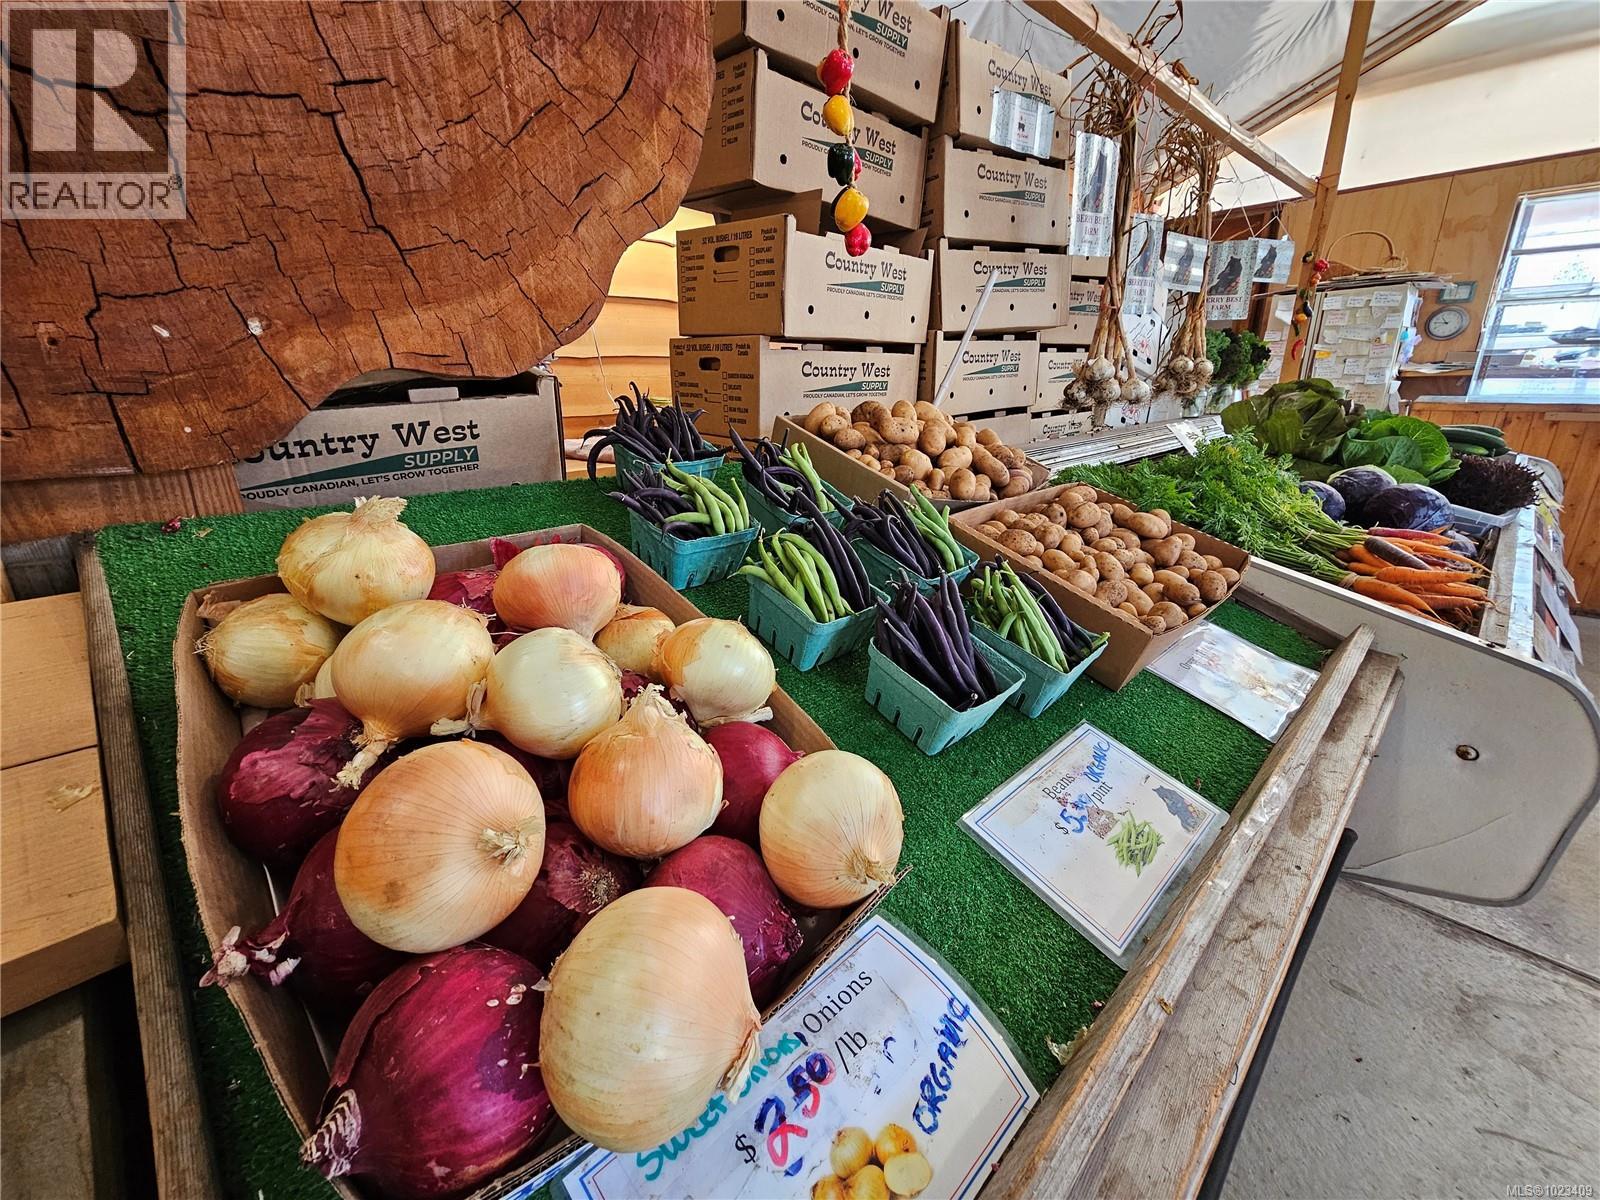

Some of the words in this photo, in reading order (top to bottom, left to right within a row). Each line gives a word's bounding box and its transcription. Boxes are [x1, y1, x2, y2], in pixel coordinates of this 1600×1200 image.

[802, 1, 828, 17] PROUDLY
[879, 0, 912, 33] West
[876, 22, 908, 48] SUPPLY
[988, 58, 1028, 92] Country
[1030, 74, 1051, 98] West
[866, 126, 897, 155] West
[864, 151, 893, 169] SUPPLY
[977, 163, 1021, 189] Country
[1024, 170, 1048, 190] West
[1024, 191, 1045, 203] SUPPLY
[826, 250, 877, 280] Country
[881, 261, 907, 281] West
[973, 260, 1019, 279] Country
[1022, 261, 1048, 276] West
[880, 282, 904, 294] SUPPLY
[1023, 278, 1045, 287] SUPPLY
[962, 350, 999, 366] Country
[1001, 350, 1022, 361] West
[1001, 365, 1019, 373] SUPPLY
[801, 360, 858, 382] Country
[861, 362, 892, 378] West
[861, 382, 888, 391] SUPPLY
[236, 432, 380, 464] untry
[391, 419, 481, 448] West
[403, 447, 476, 468] SUPPLY
[292, 479, 359, 495] CANADIAN,
[361, 474, 391, 486] LET'S
[392, 469, 426, 481] GROW
[427, 463, 480, 477] TOGETHER
[1042, 773, 1076, 800] Beans
[1055, 821, 1069, 836] $
[802, 970, 873, 1034] Onions
[912, 997, 971, 1135] ORGANIC
[735, 1133, 757, 1165] $
[834, 1031, 868, 1075] /lb
